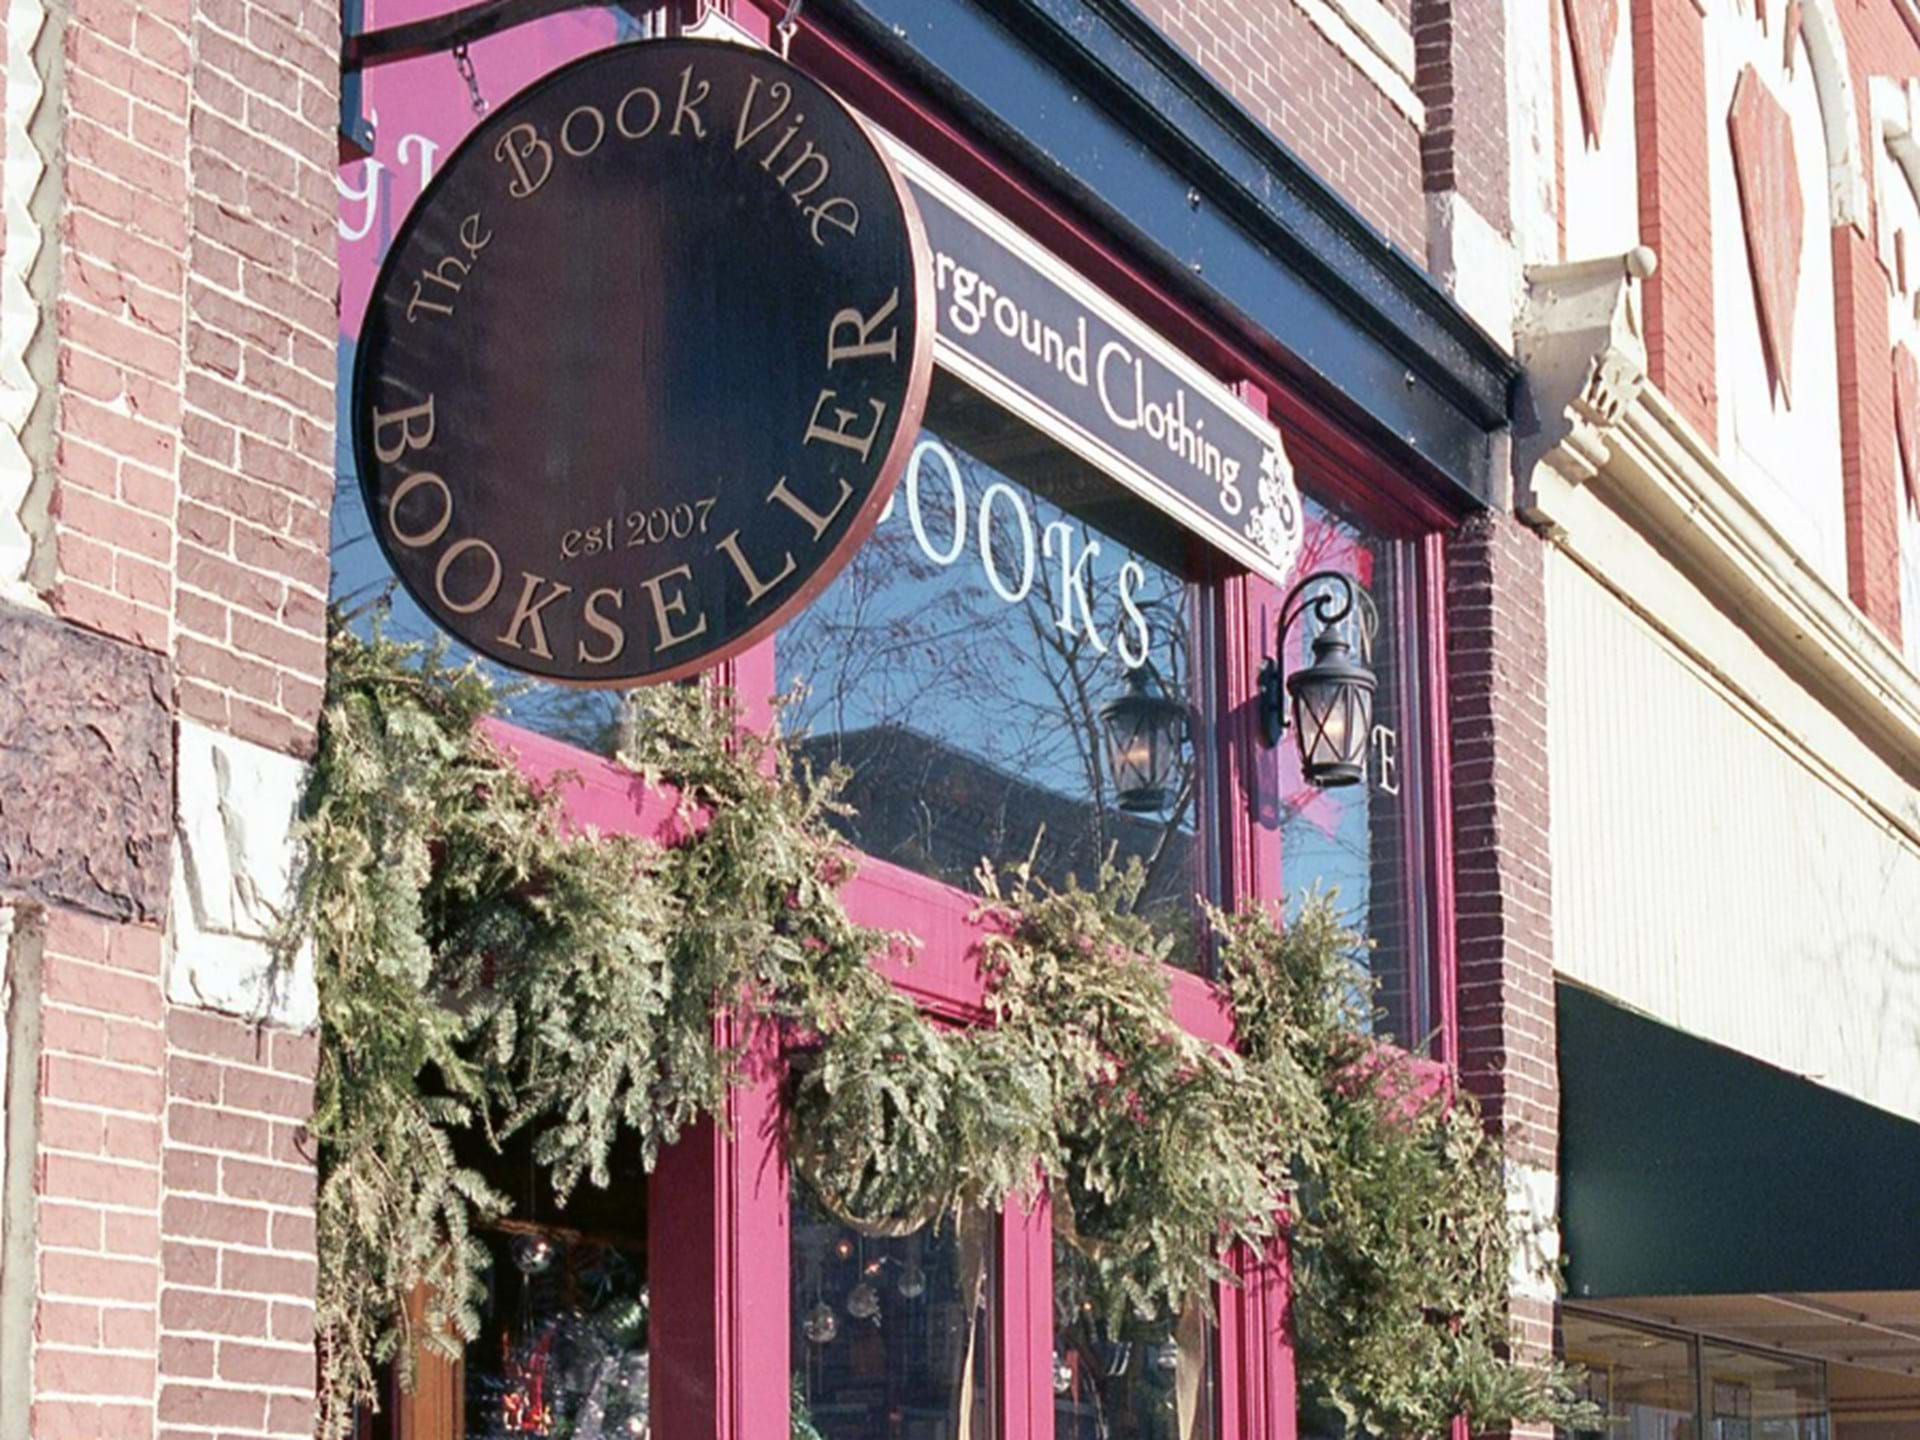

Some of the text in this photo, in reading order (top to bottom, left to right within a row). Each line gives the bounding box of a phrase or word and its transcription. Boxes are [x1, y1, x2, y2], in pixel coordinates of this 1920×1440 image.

[406, 212, 494, 325] The
[732, 74, 862, 247] Vine
[372, 286, 899, 665] BOOKSELLER
[932, 251, 1244, 514] rground Clothing
[626, 496, 718, 547] 2007
[876, 439, 1151, 670] OOKS
